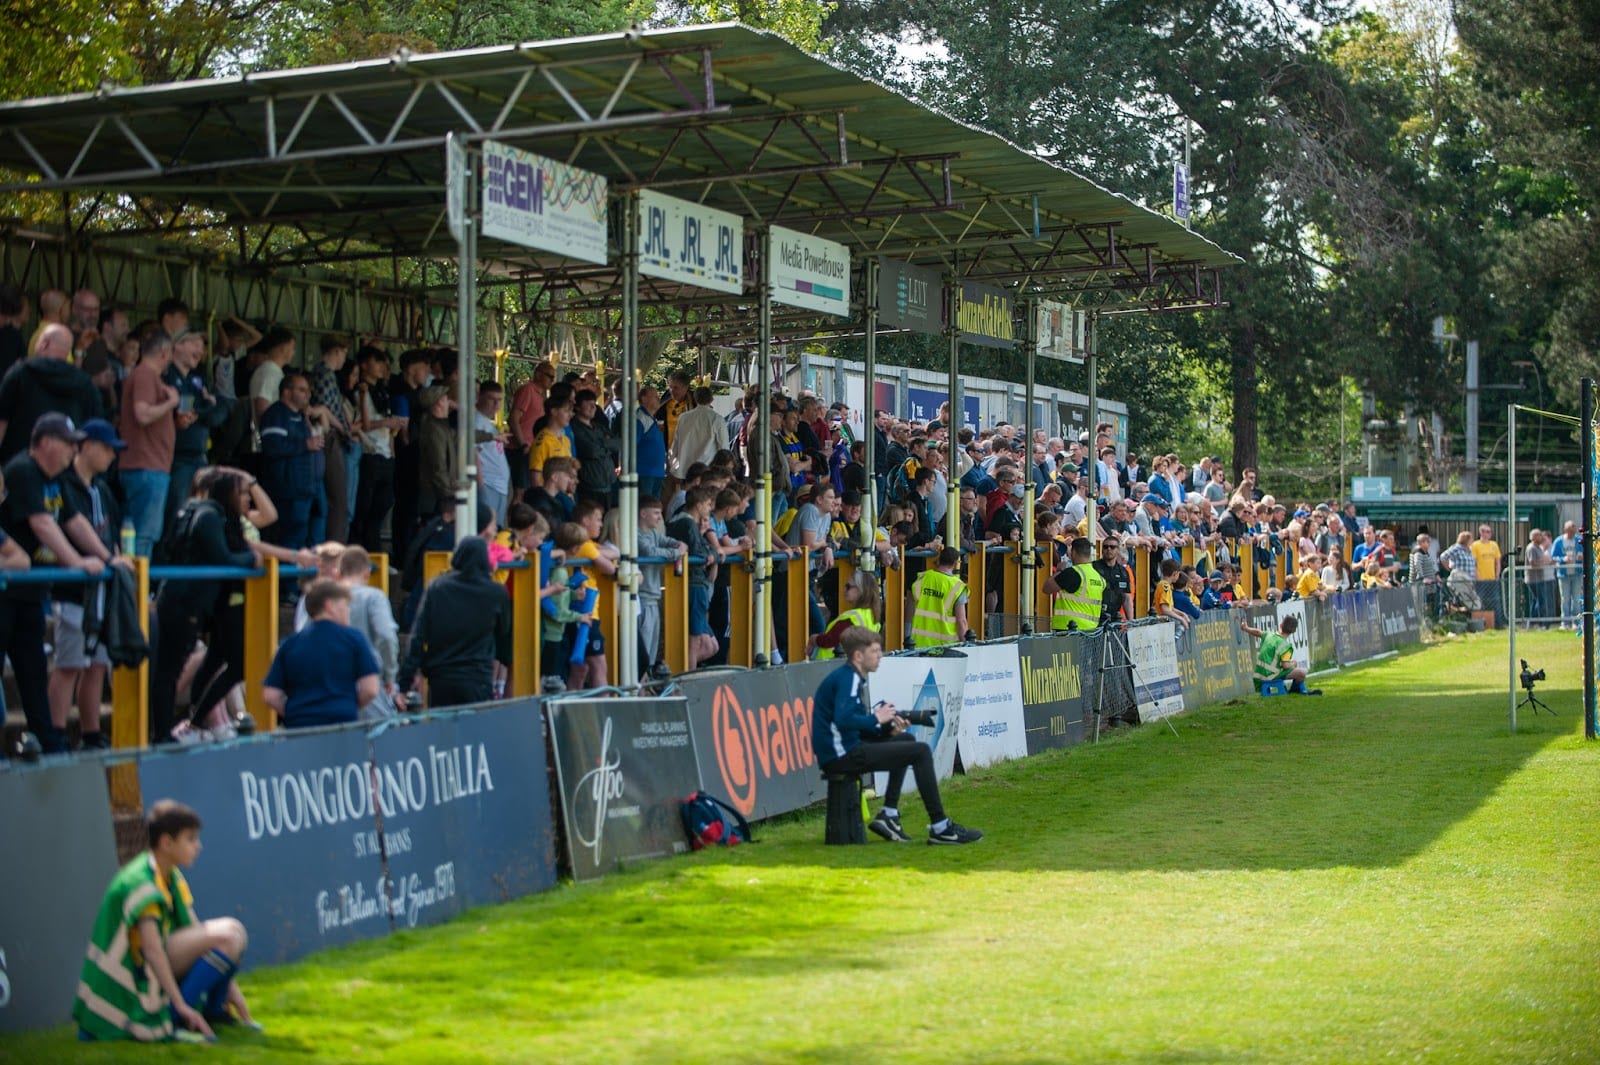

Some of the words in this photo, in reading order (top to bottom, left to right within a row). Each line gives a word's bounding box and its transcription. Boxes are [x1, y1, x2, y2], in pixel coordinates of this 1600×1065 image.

[504, 158, 544, 216] GEM
[644, 205, 670, 259] JRL
[680, 215, 705, 267] JRL
[715, 224, 738, 275] JRL
[780, 241, 802, 270] Media
[803, 248, 845, 280] Powerhouse
[923, 588, 945, 599] STEWAR
[1050, 715, 1066, 736] PIZZA
[241, 756, 427, 840] BUONGIORNO
[428, 742, 494, 806] ITALIA
